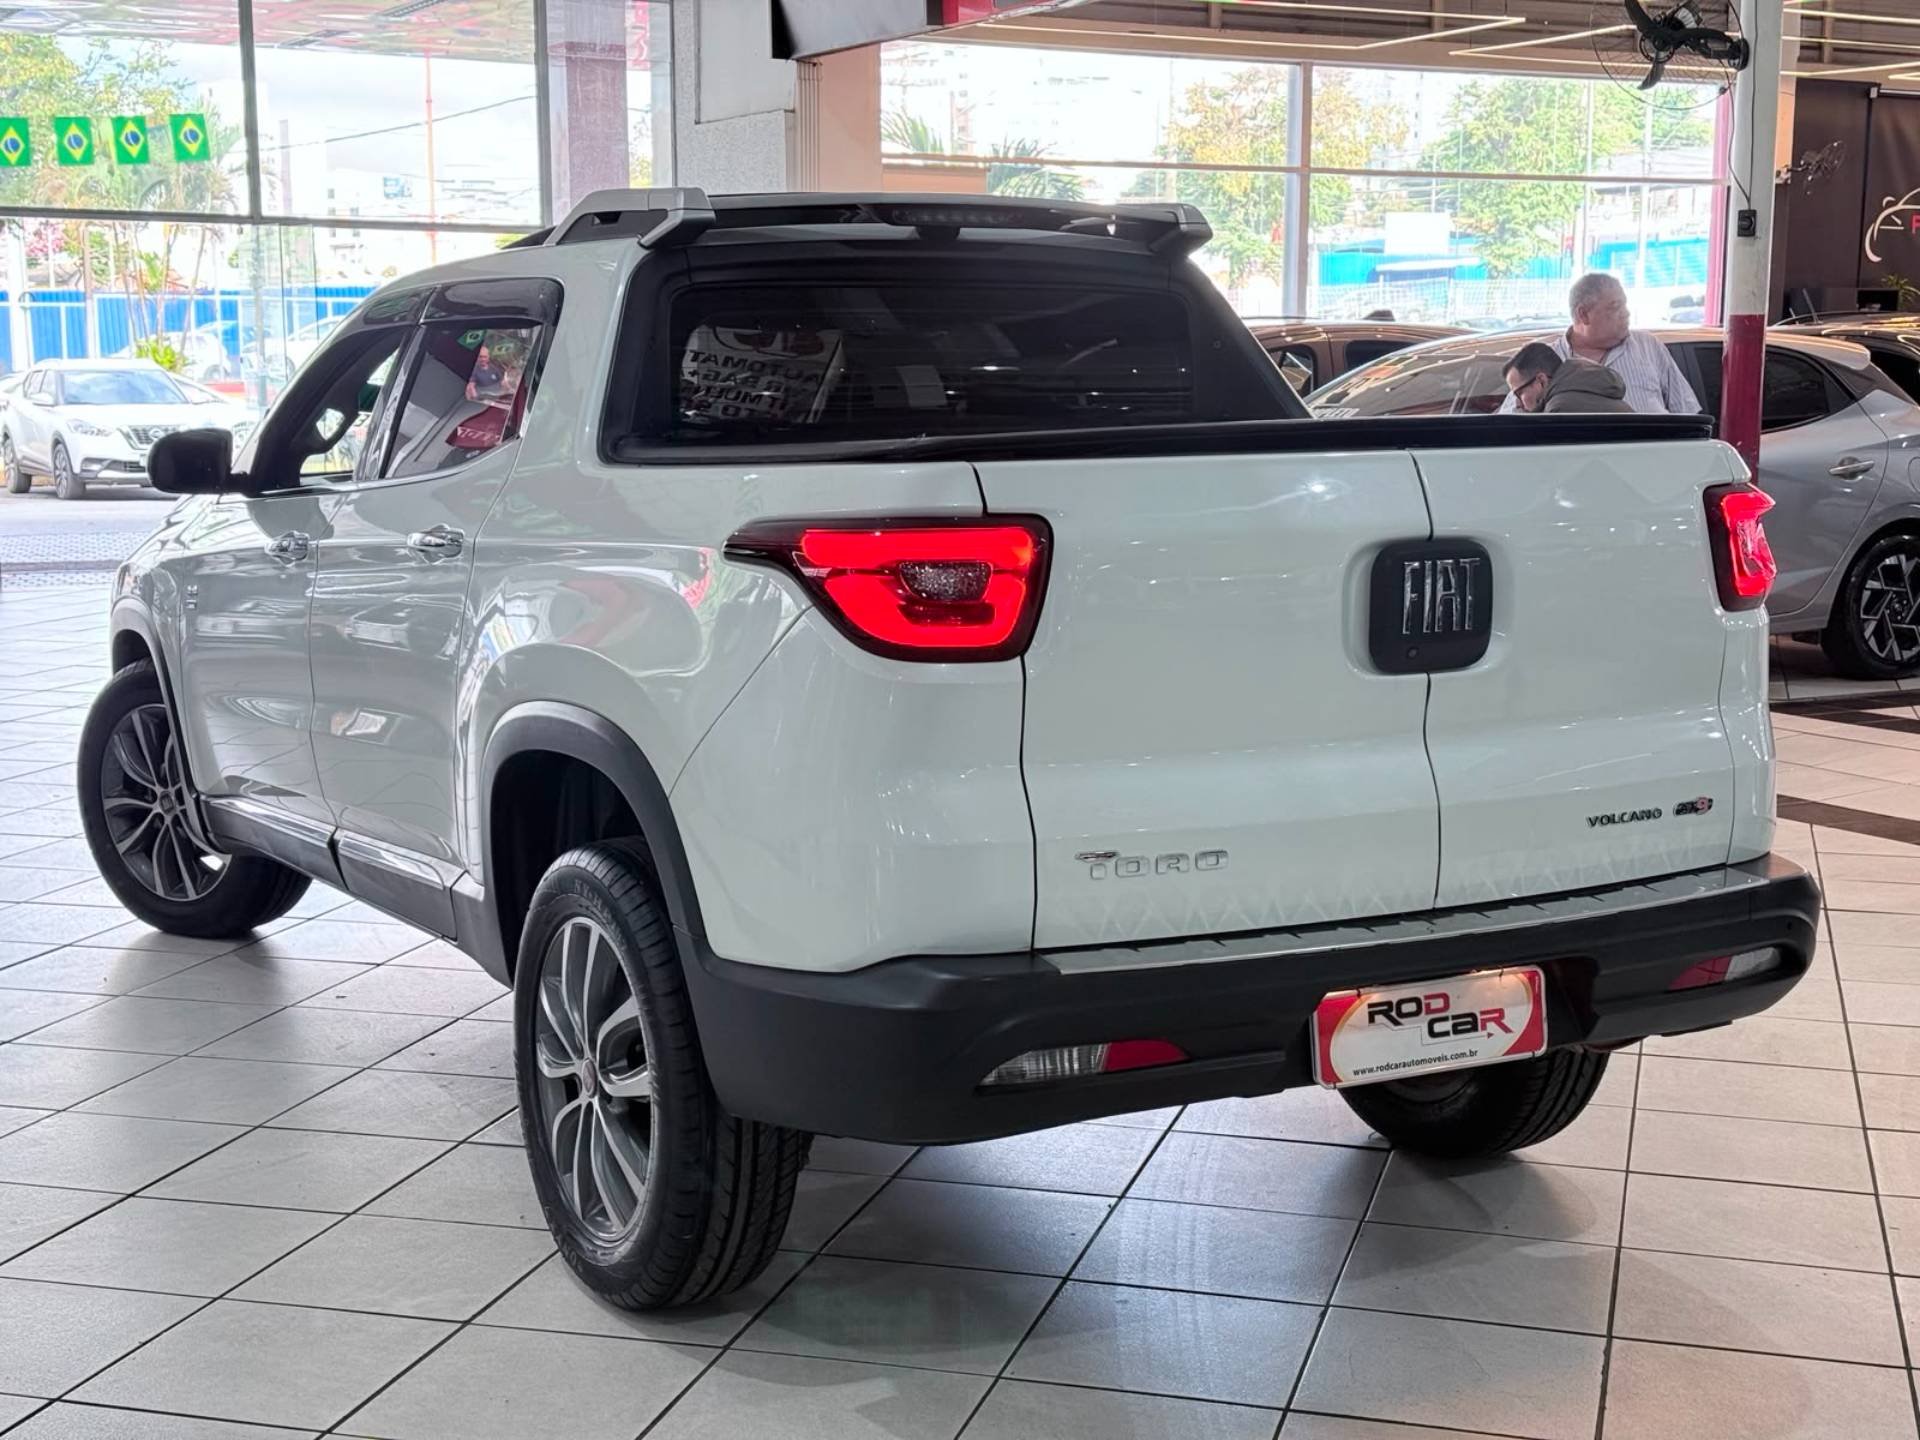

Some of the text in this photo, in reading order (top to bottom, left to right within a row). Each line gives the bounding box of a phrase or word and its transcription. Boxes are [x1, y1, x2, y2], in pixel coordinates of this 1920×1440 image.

[1402, 557, 1481, 635] FIAT
[1587, 807, 1663, 828] VOLCANO
[1075, 849, 1230, 880] TORO
[1367, 992, 1451, 1026] ROD
[1352, 1048, 1479, 1076] www.rodcarautomoveis.com.br
